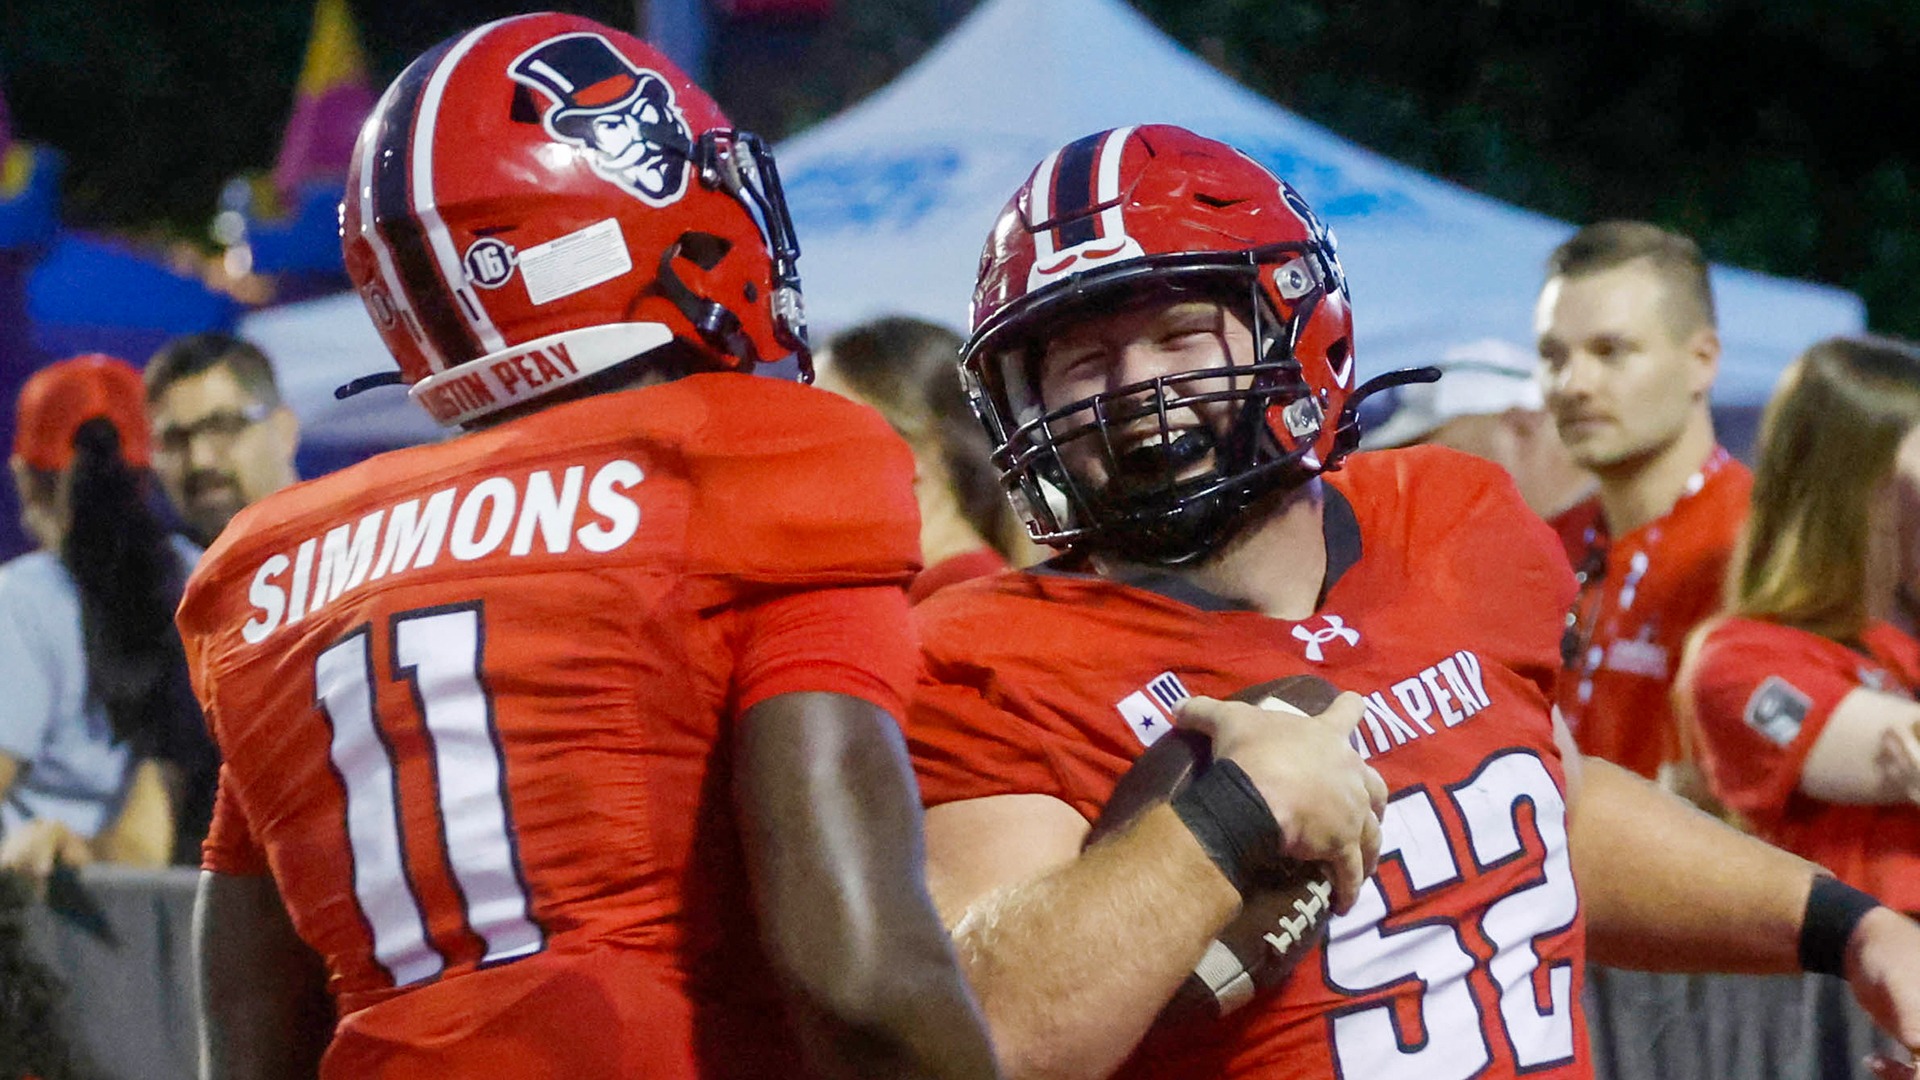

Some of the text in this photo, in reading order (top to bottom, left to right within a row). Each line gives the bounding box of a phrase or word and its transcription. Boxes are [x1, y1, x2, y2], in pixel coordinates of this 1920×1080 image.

[472, 245, 506, 283] 16
[490, 341, 579, 396] PEAY
[241, 459, 645, 644] SIMMONS
[1390, 649, 1492, 730] PEAY
[314, 600, 548, 988] 11
[1322, 747, 1578, 1080] 52
